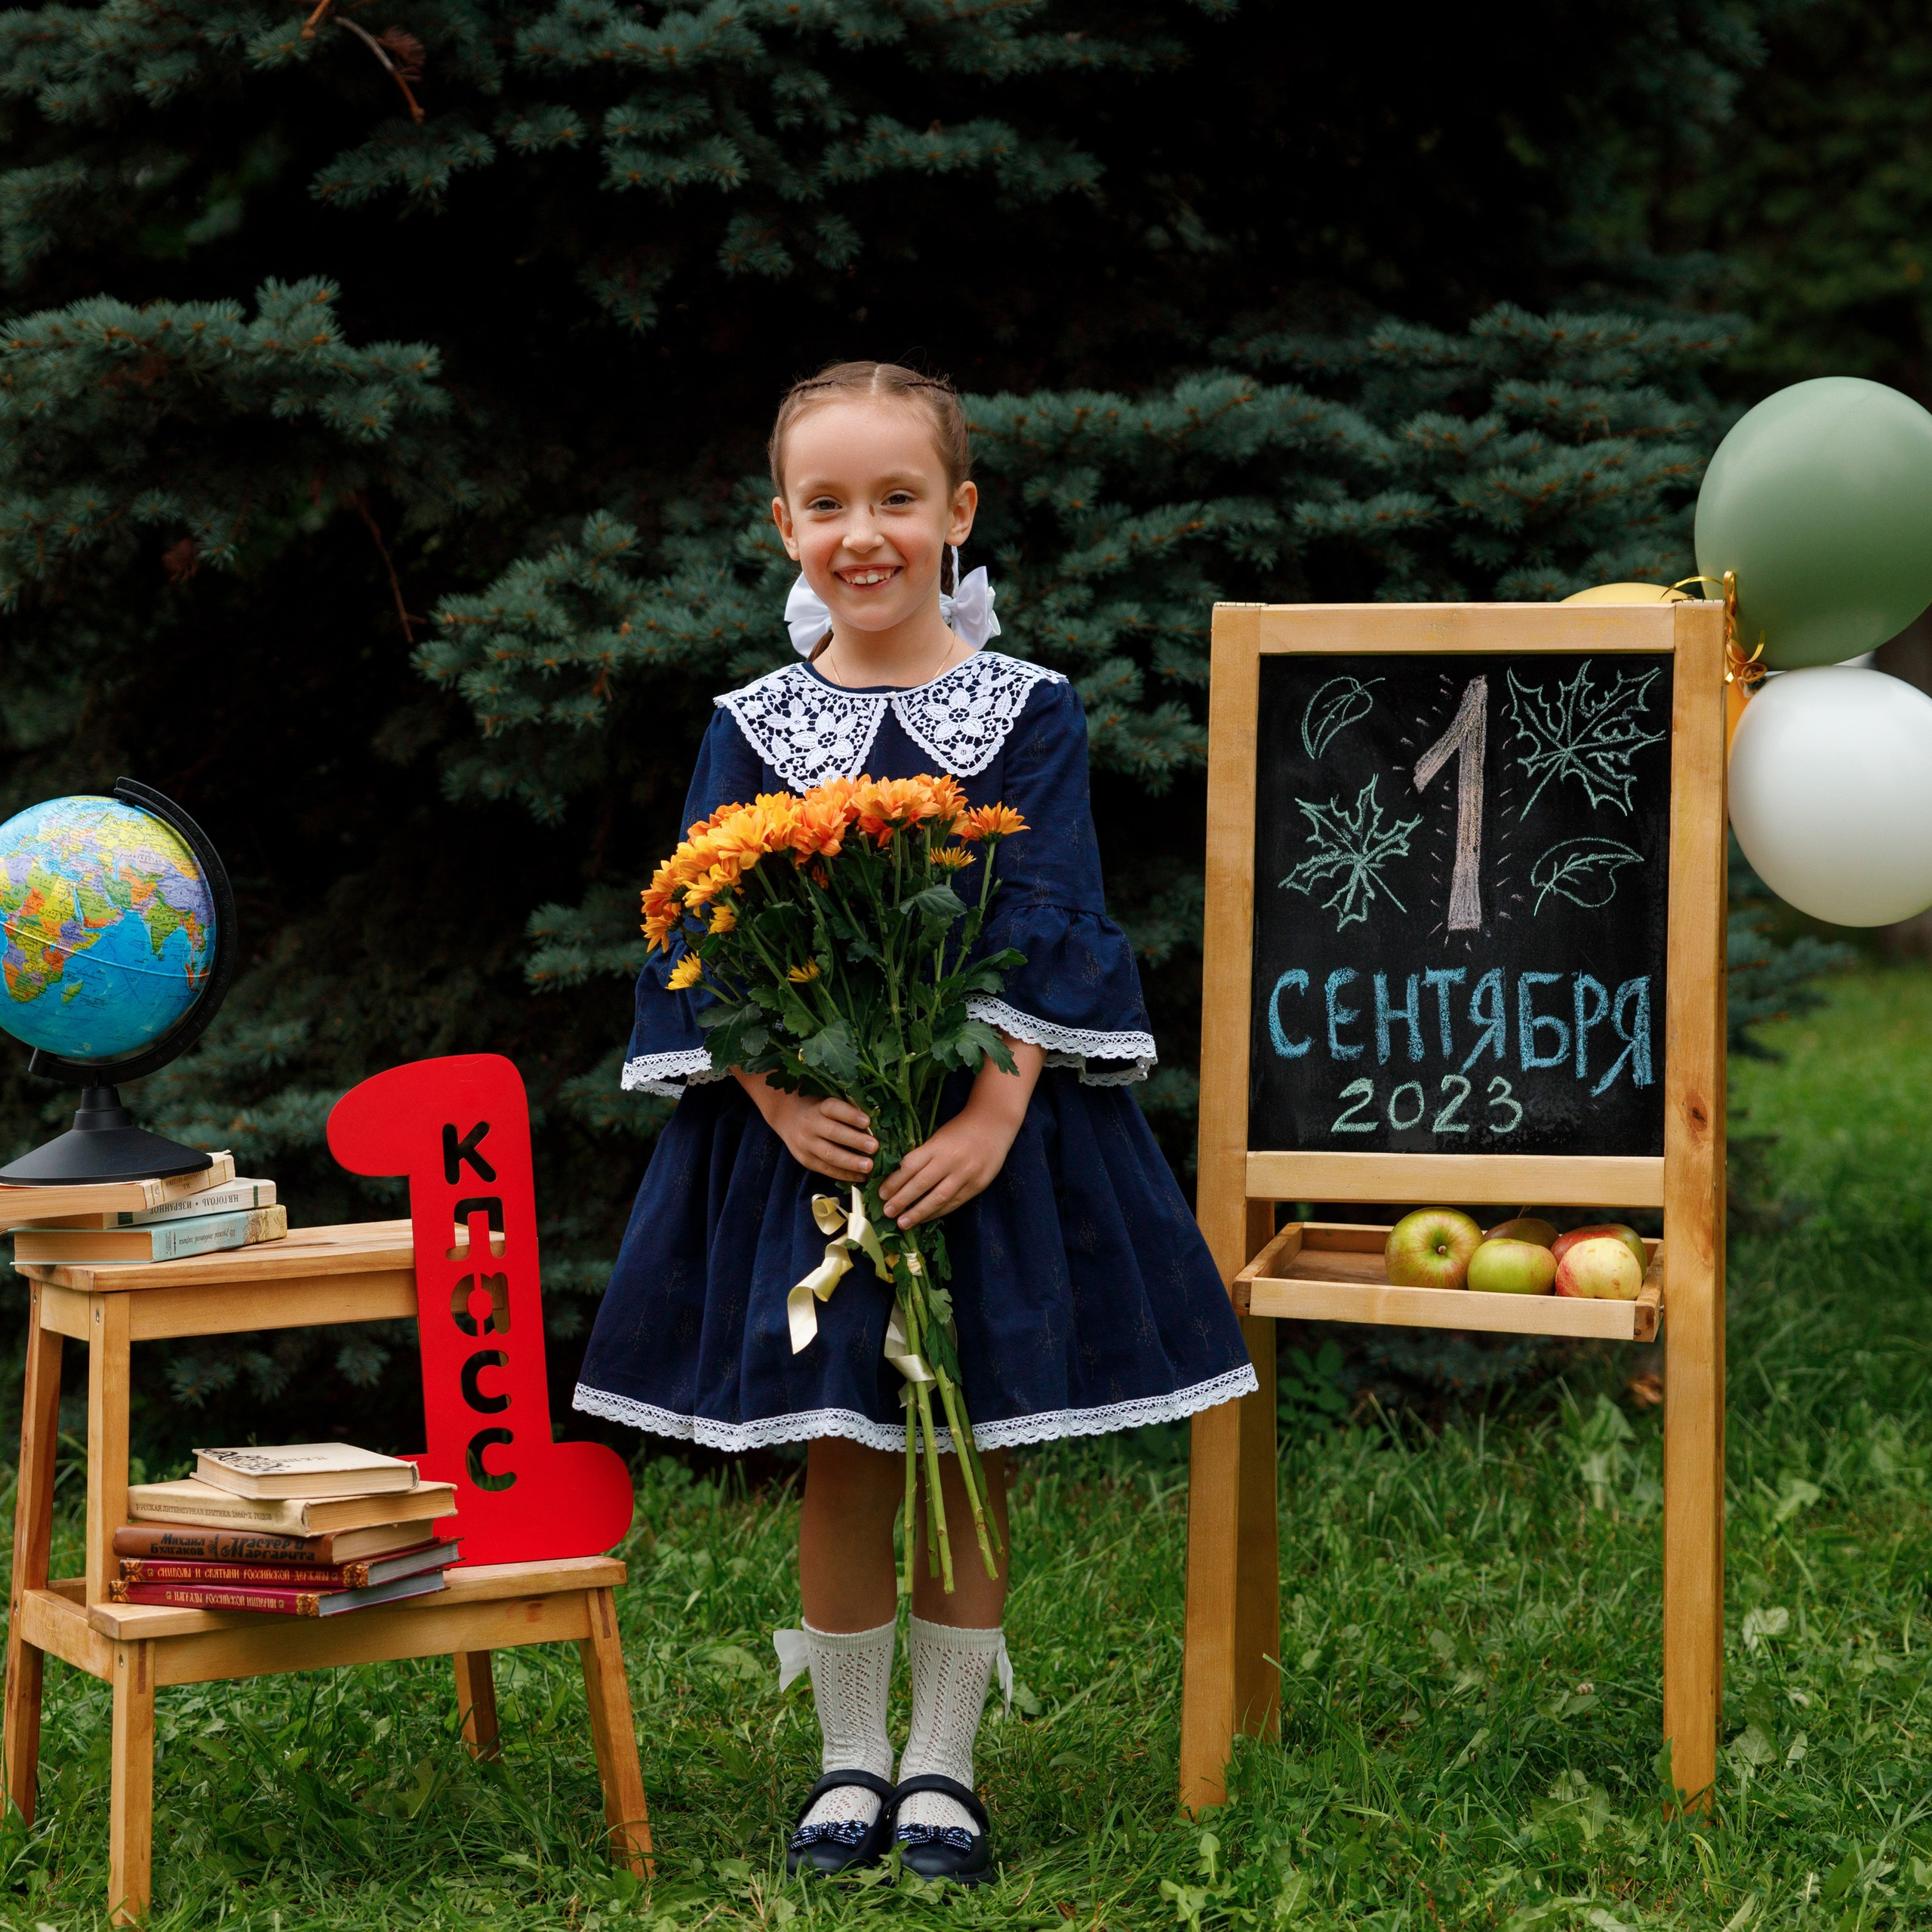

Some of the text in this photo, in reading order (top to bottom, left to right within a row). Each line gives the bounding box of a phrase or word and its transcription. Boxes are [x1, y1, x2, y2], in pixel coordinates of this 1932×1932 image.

[1413, 673, 1488, 931] 1
[1268, 966, 1656, 1097] СЕНТЯБРЯ
[1331, 1074, 1523, 1133] 2023
[136, 1503, 162, 1512] РУССКАЯ
[162, 1505, 205, 1515] ЛИТЕРАТУРНАЯ
[205, 1509, 231, 1518] КРИТИКА
[254, 1512, 272, 1521] ГОДОВ
[150, 1543, 205, 1555] Булгаков
[161, 1534, 205, 1546] Михаил
[157, 1567, 329, 1581] СИМВОЛЫ И СВЯТЫНИ РОССИЙСКОЙ ДЕРЖАВЫ
[174, 1591, 277, 1609] НАГРАДЫ РОССИЙСКОЙ ИМПЕРИИ
